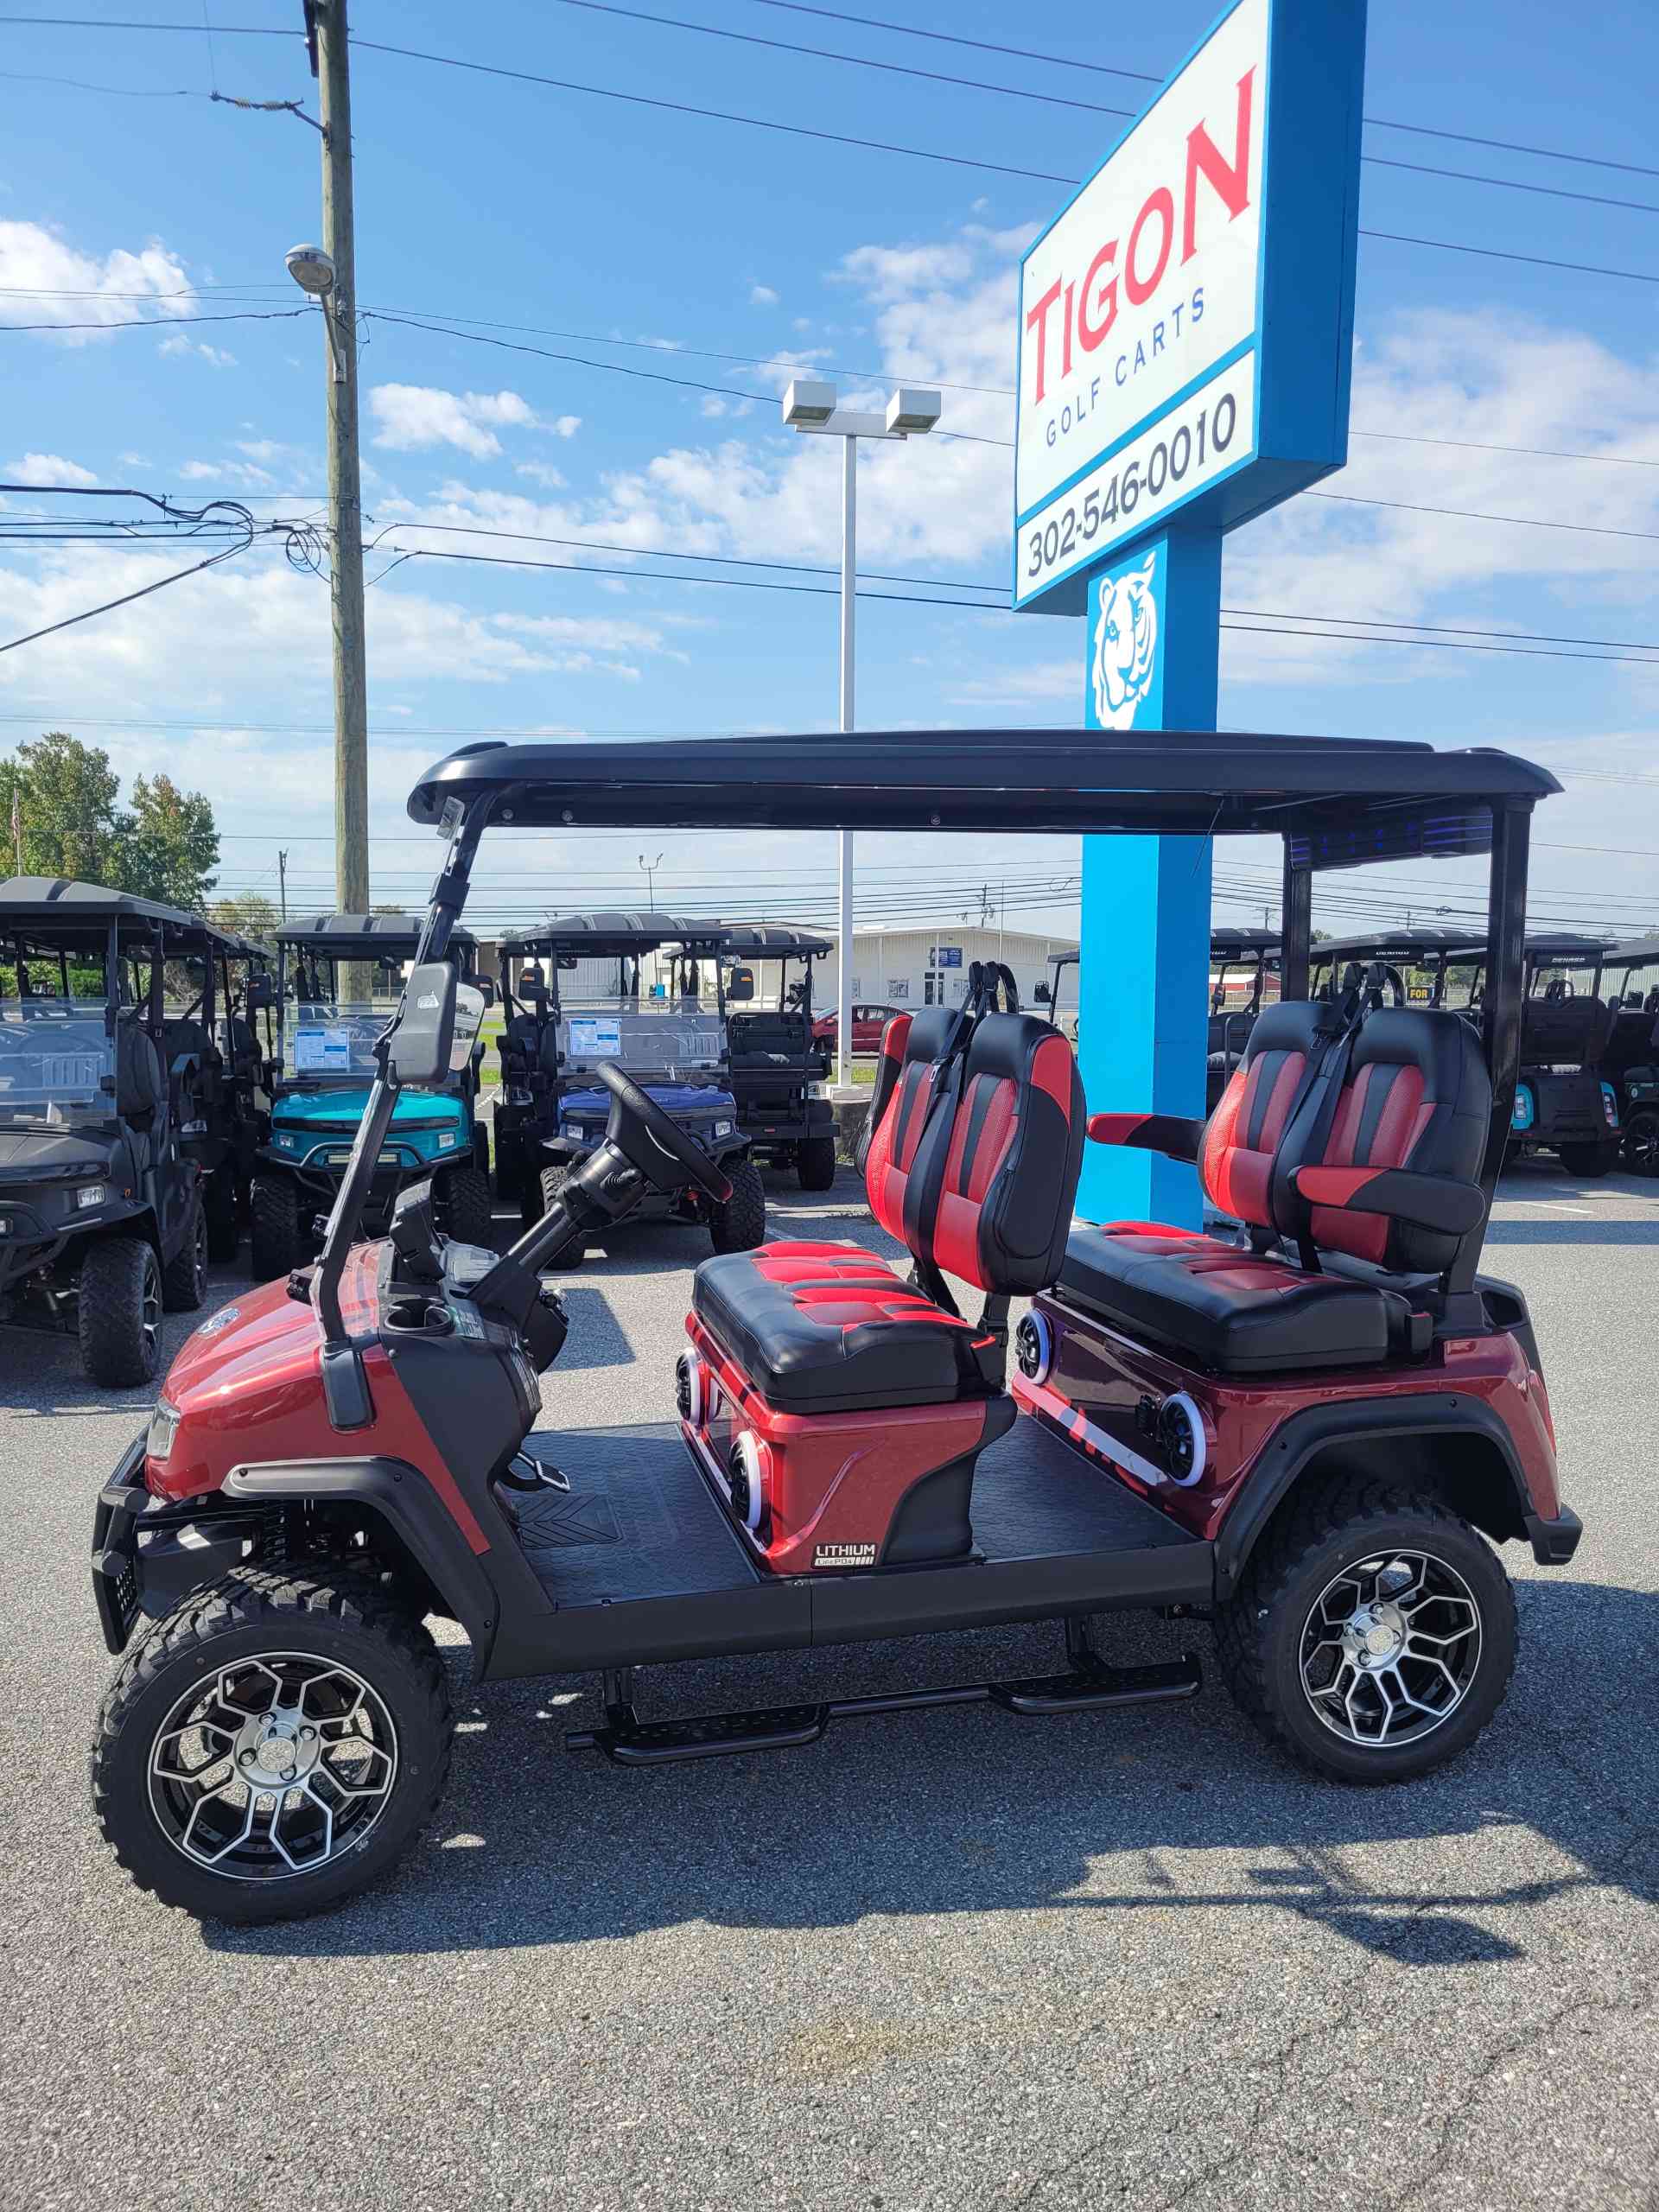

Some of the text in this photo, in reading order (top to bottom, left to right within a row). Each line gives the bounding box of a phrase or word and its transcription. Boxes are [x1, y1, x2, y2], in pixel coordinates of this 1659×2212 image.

[1027, 65, 1256, 406] TIGON
[1046, 287, 1205, 447] GOLF CARTS
[1028, 393, 1236, 577] 302-546-0010
[1410, 988, 1428, 999] FOR
[817, 1544, 875, 1556] LITHIUM
